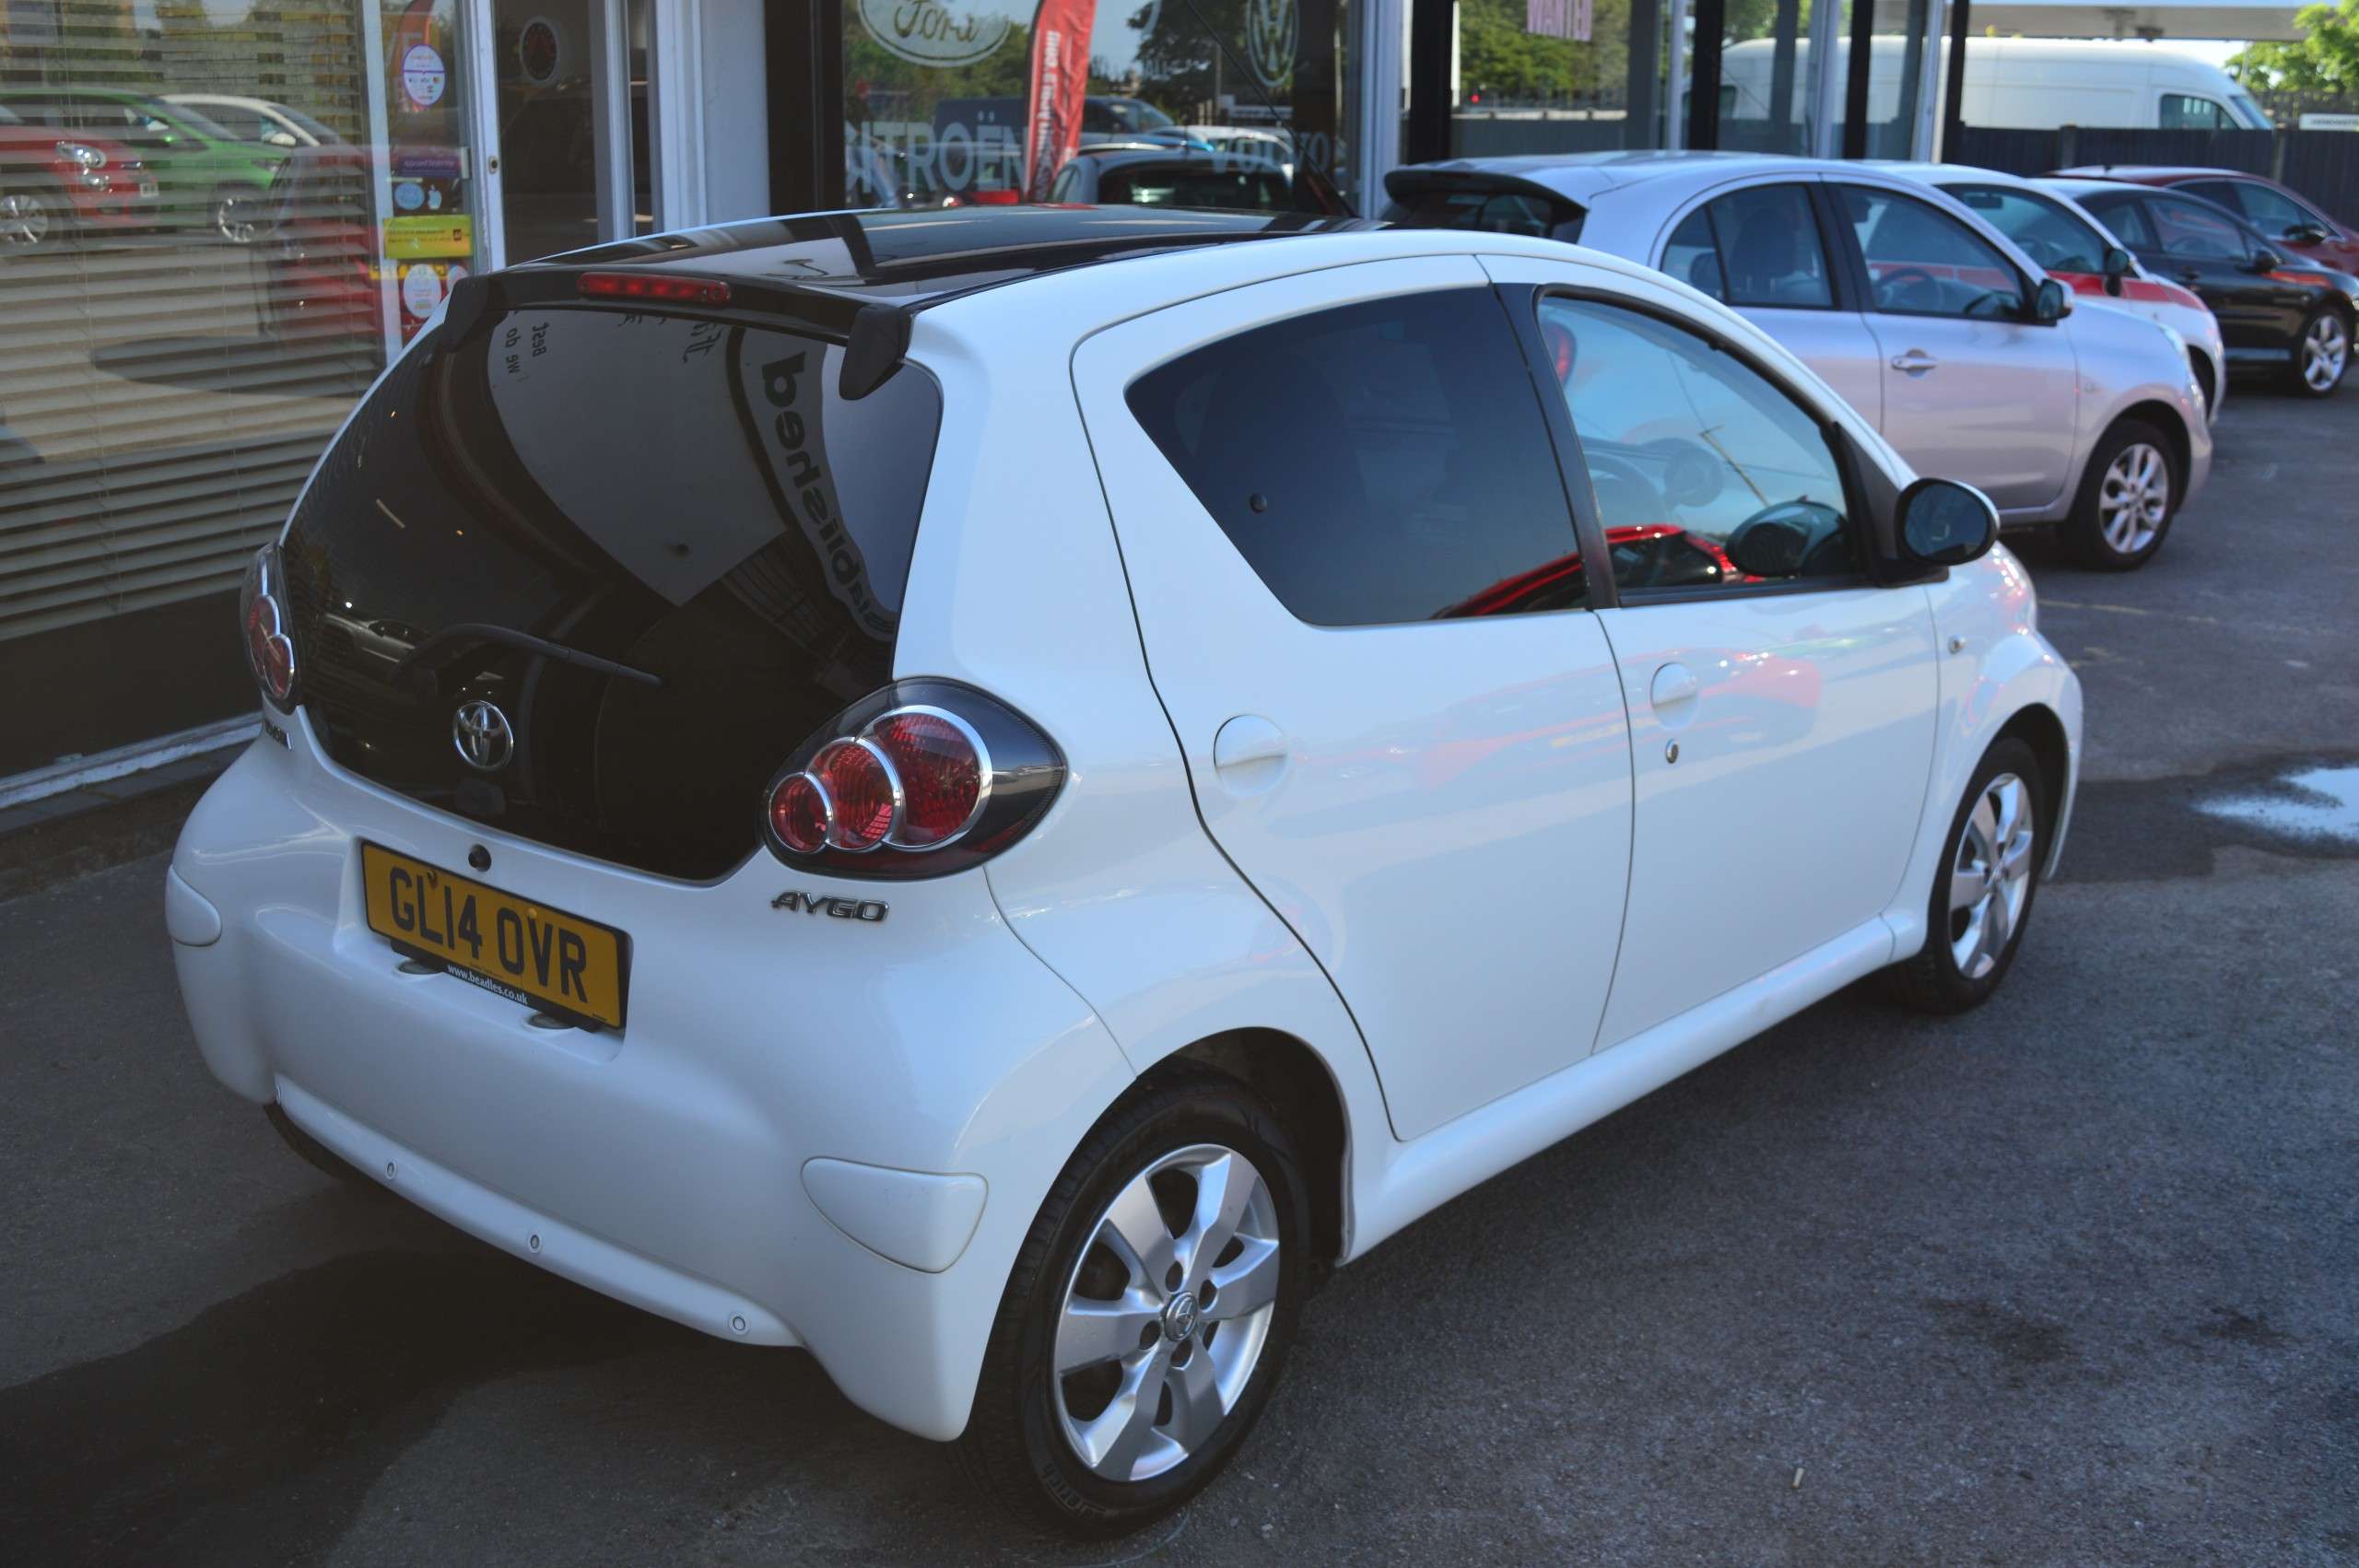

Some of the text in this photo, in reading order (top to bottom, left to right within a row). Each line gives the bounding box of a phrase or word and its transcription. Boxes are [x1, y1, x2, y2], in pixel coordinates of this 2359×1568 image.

[770, 889, 890, 923] AYGO
[390, 866, 588, 1003] GL14 OVR
[447, 964, 529, 1006] www.beadles.co.uk
